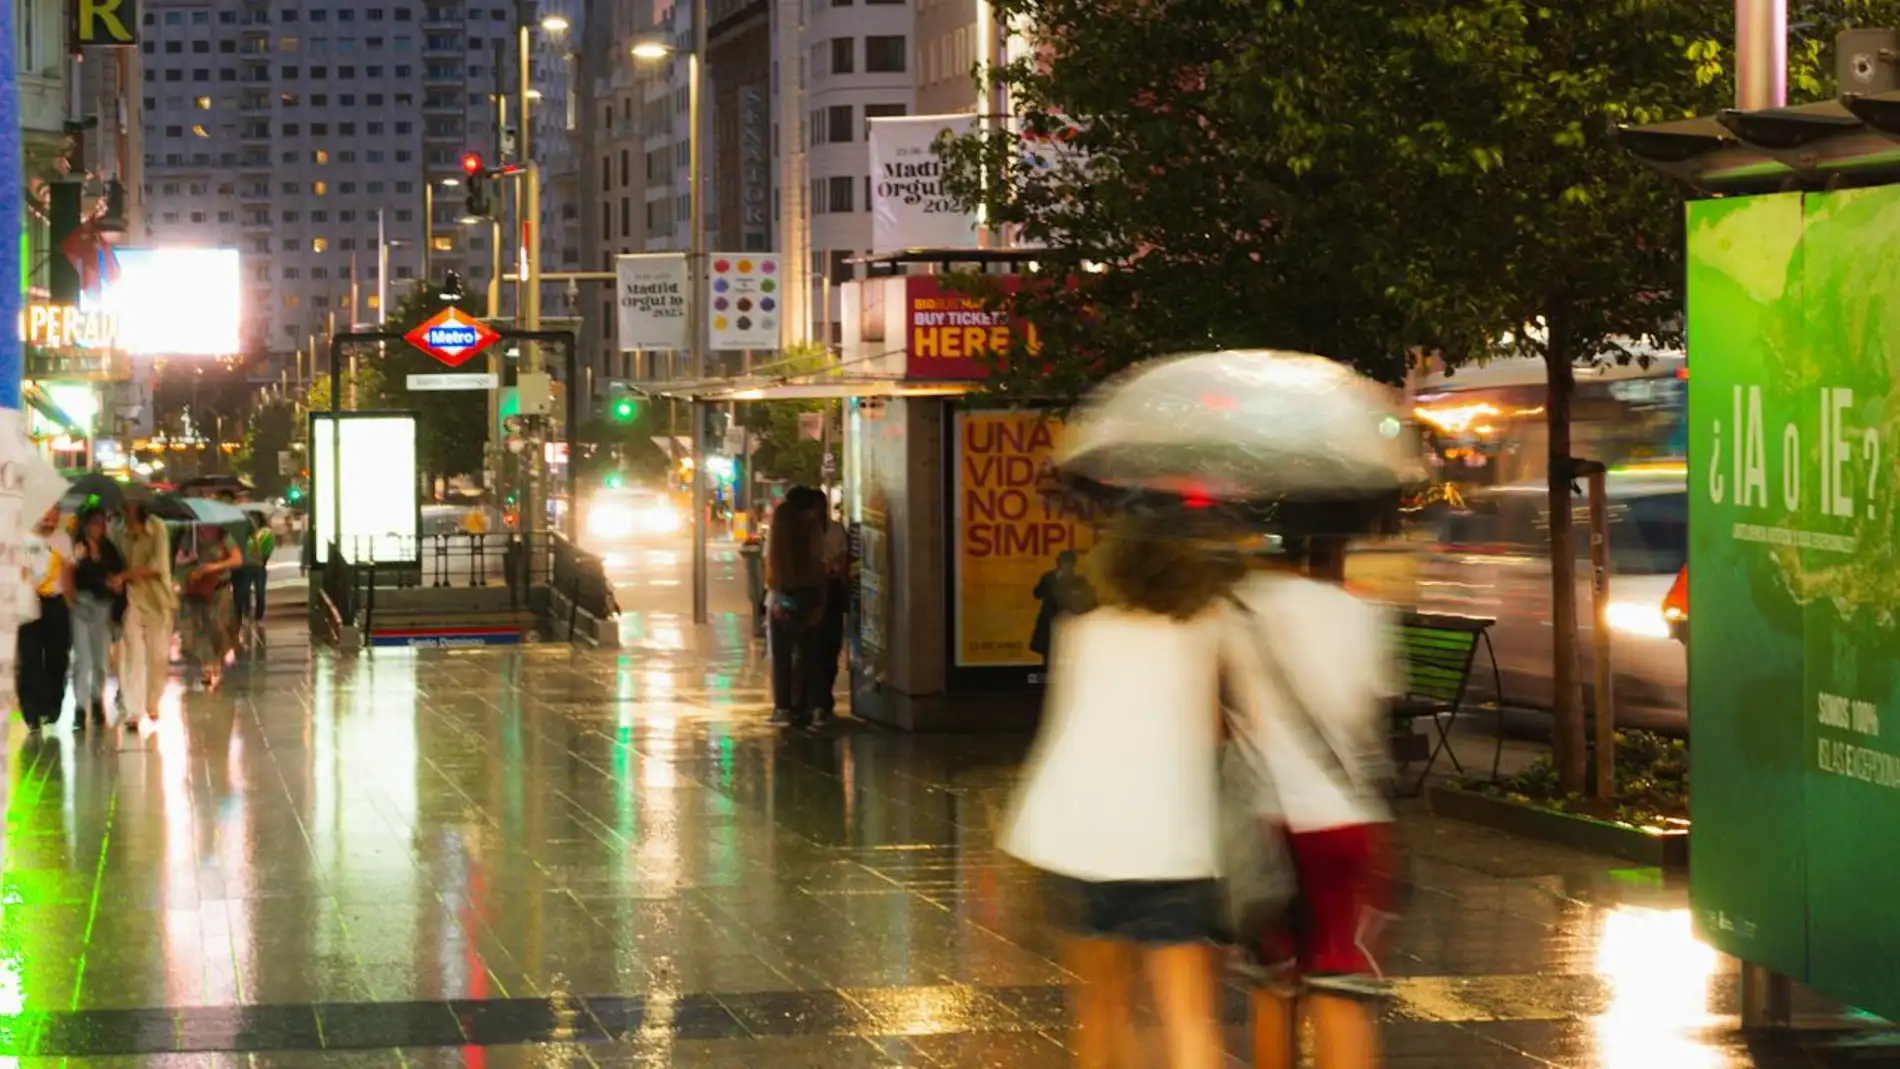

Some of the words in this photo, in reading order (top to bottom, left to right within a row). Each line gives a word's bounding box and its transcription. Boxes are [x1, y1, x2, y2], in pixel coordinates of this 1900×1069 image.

[884, 160, 947, 179] Madri
[878, 180, 946, 206] Orgul
[627, 282, 678, 295] Madrid
[914, 311, 945, 326] BUY
[431, 330, 474, 345] Metro
[914, 326, 1011, 358] HERE
[966, 421, 1054, 454] UNA
[966, 455, 1062, 488] VIDA
[967, 488, 1029, 522] NO
[967, 522, 1091, 558] SIMPL
